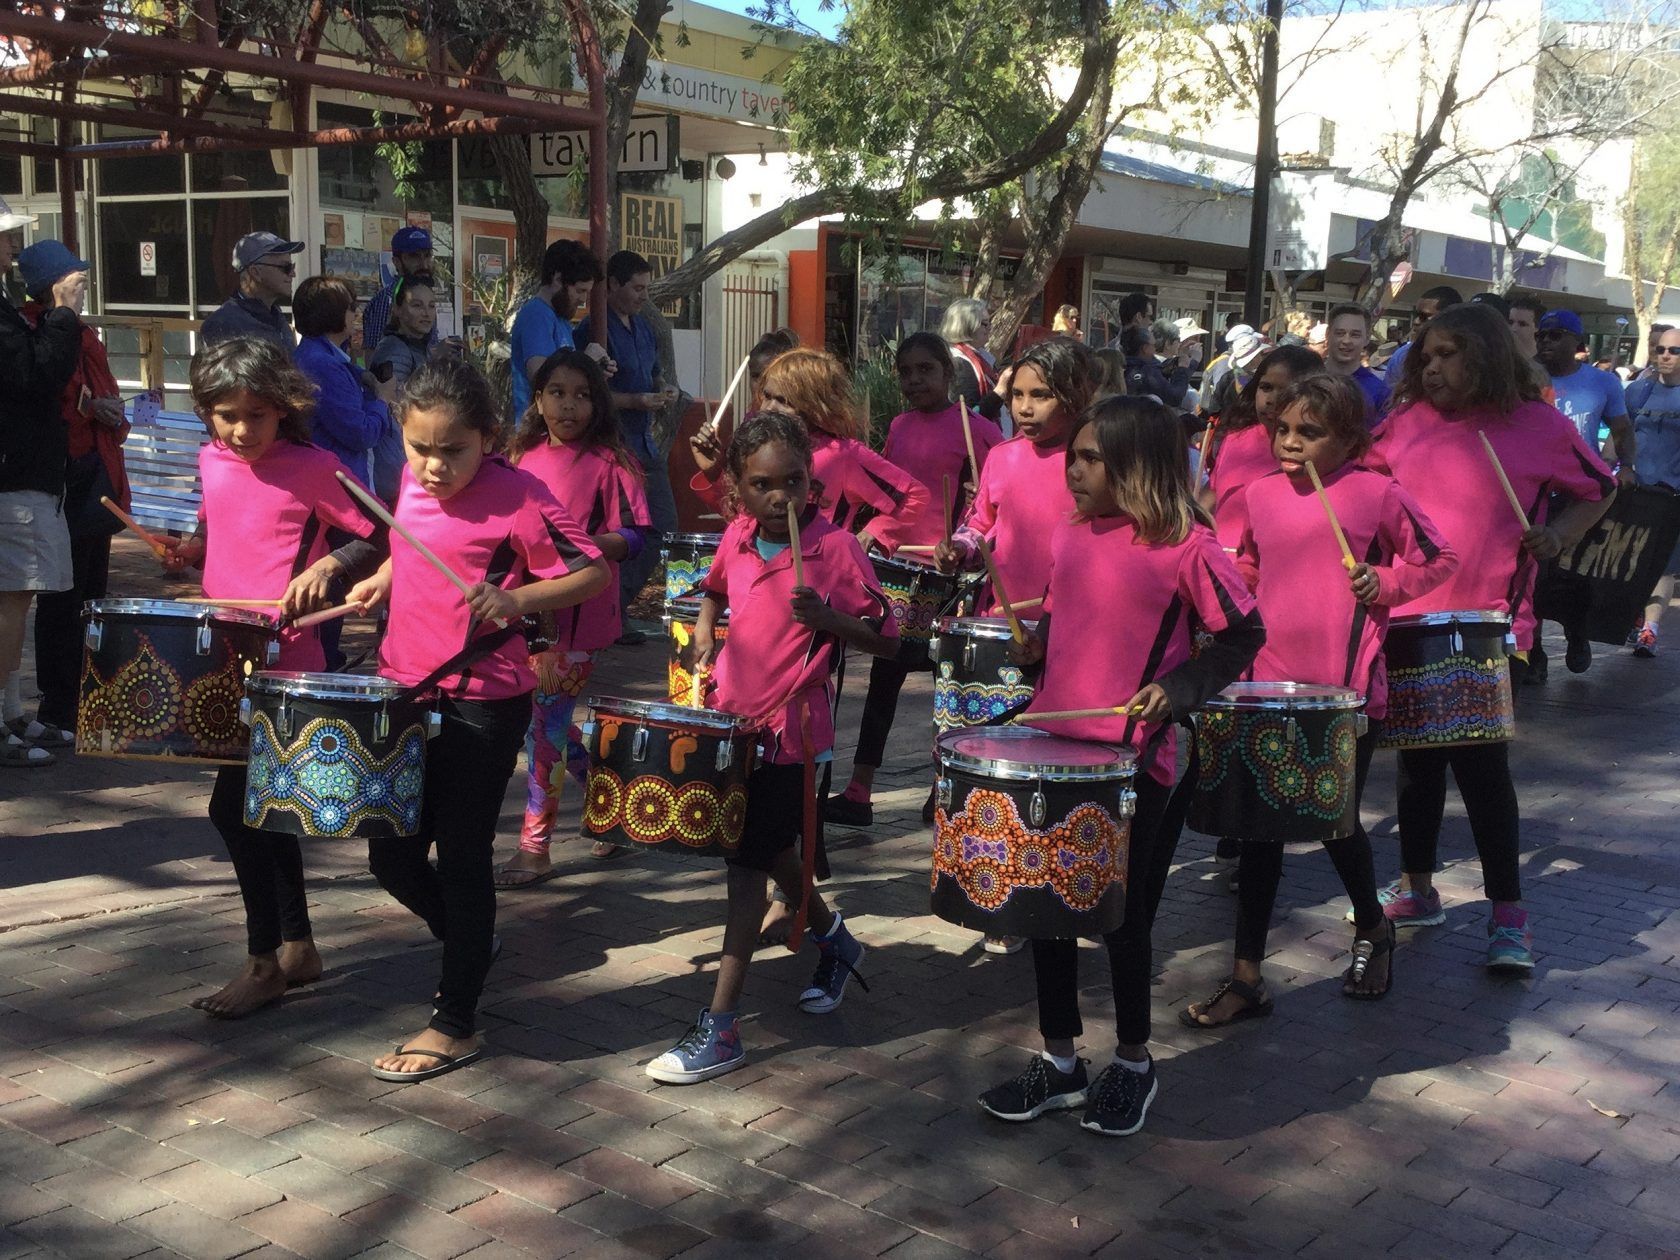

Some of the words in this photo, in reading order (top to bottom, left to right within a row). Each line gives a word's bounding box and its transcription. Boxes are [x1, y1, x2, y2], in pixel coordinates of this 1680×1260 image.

[626, 197, 678, 240] REAL
[626, 237, 679, 256] AUSTRALIANS
[1564, 400, 1573, 416] &
